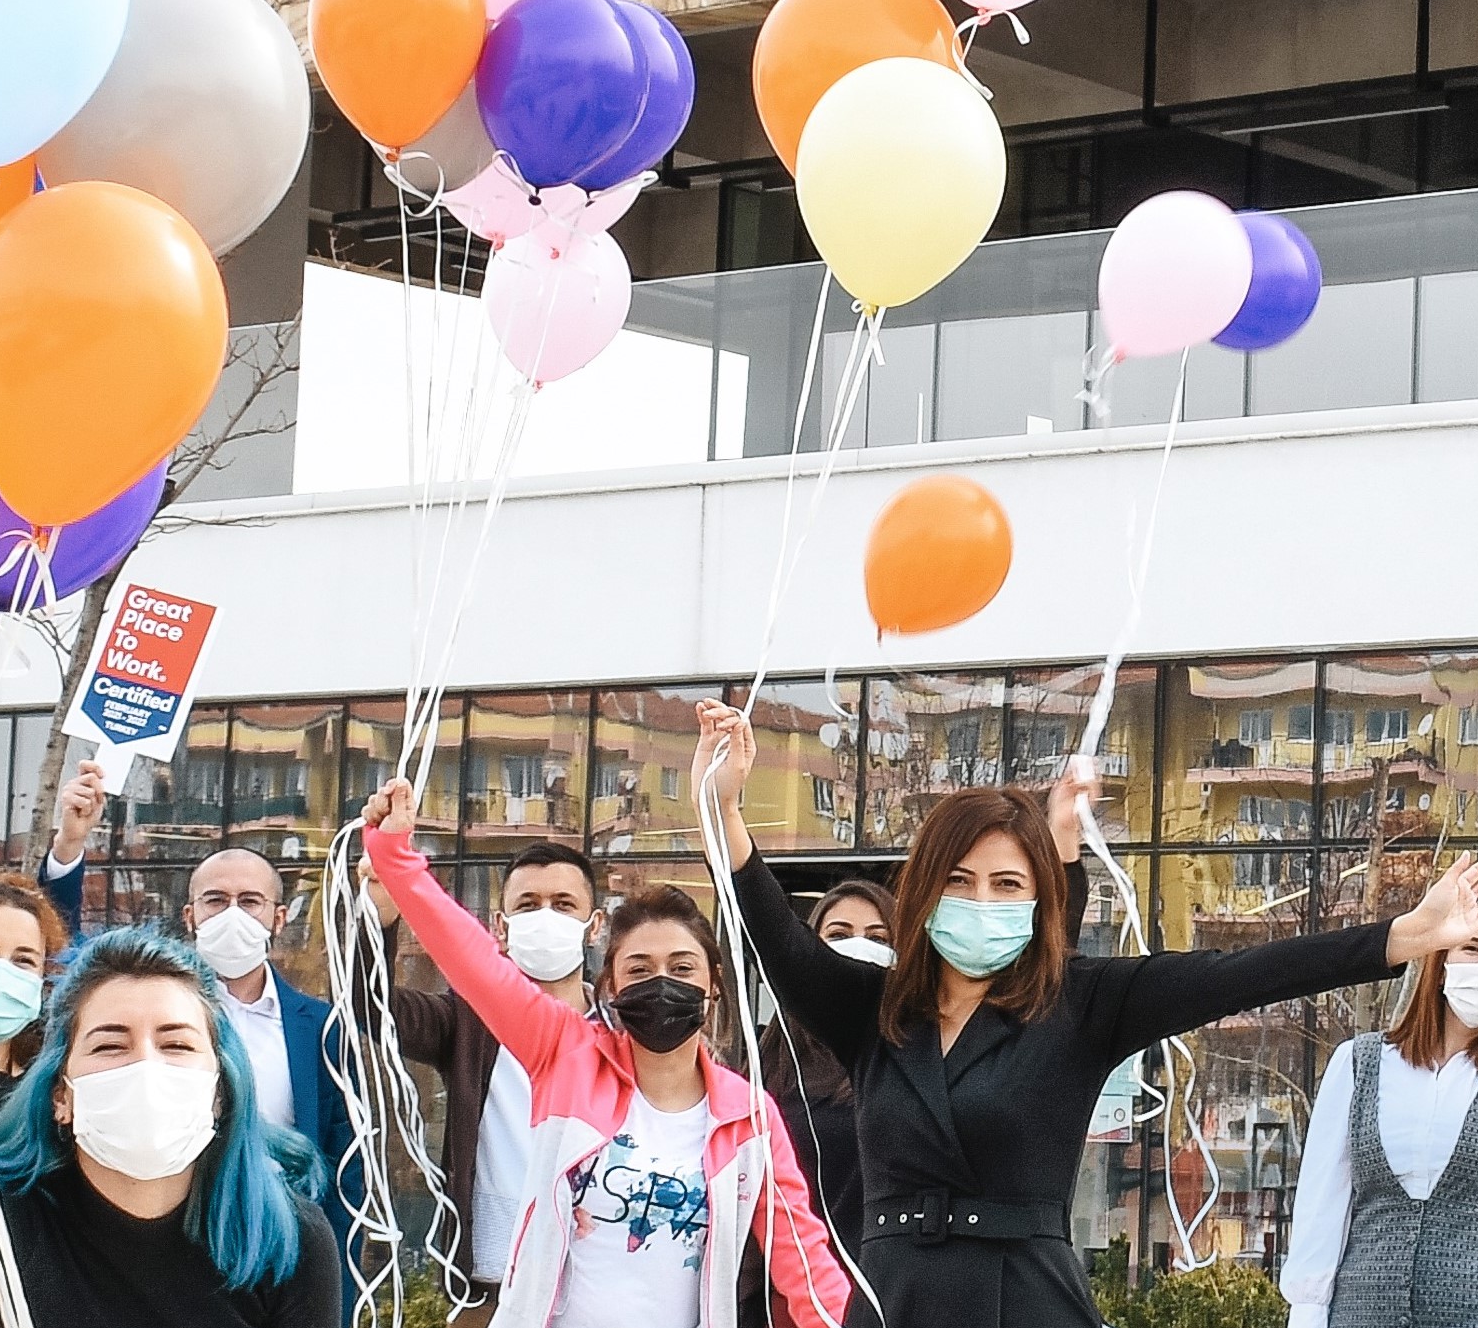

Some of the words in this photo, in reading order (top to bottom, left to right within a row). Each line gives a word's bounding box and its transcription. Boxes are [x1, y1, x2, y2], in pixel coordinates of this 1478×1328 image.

[127, 590, 192, 623] Great
[114, 628, 138, 650] To
[121, 609, 183, 642] Place
[93, 677, 175, 712] Certified
